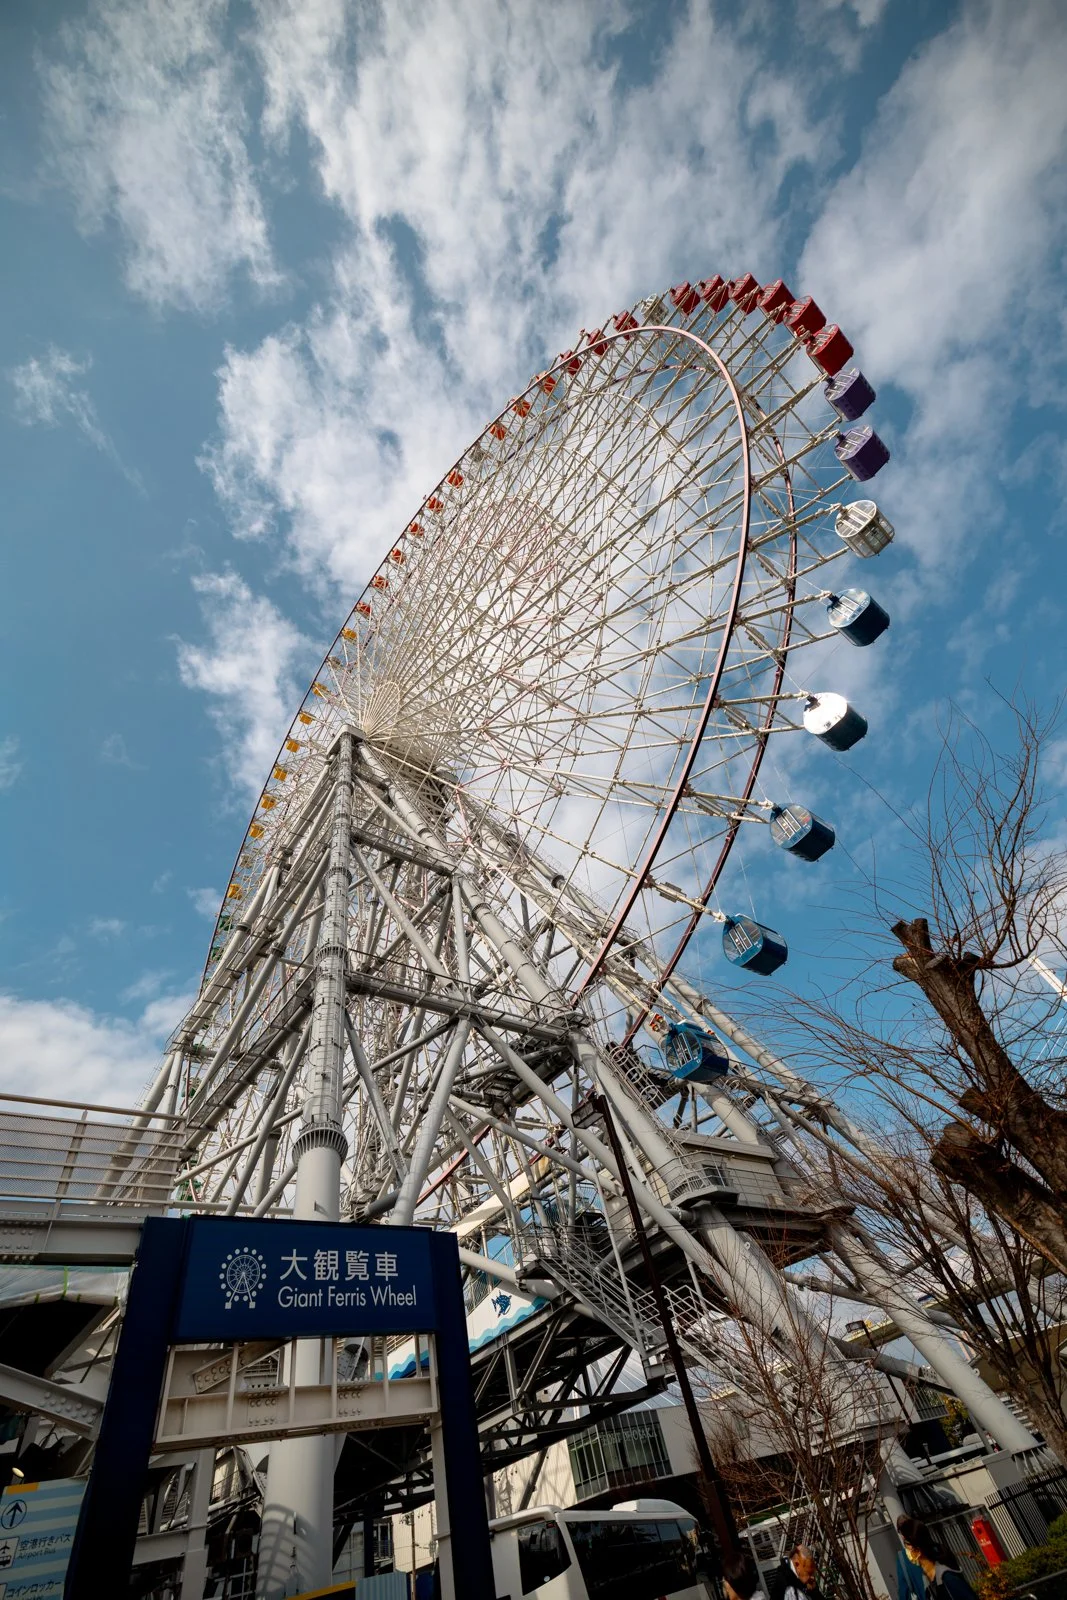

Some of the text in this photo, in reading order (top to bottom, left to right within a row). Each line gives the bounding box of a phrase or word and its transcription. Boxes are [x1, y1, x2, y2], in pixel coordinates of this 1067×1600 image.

[279, 1249, 399, 1282] 大観覧車
[277, 1284, 417, 1308] Giant Ferris Wheel
[19, 1534, 71, 1551] 空港行きバス
[17, 1550, 43, 1559] Airport
[6, 1580, 62, 1598] コインロッカー
